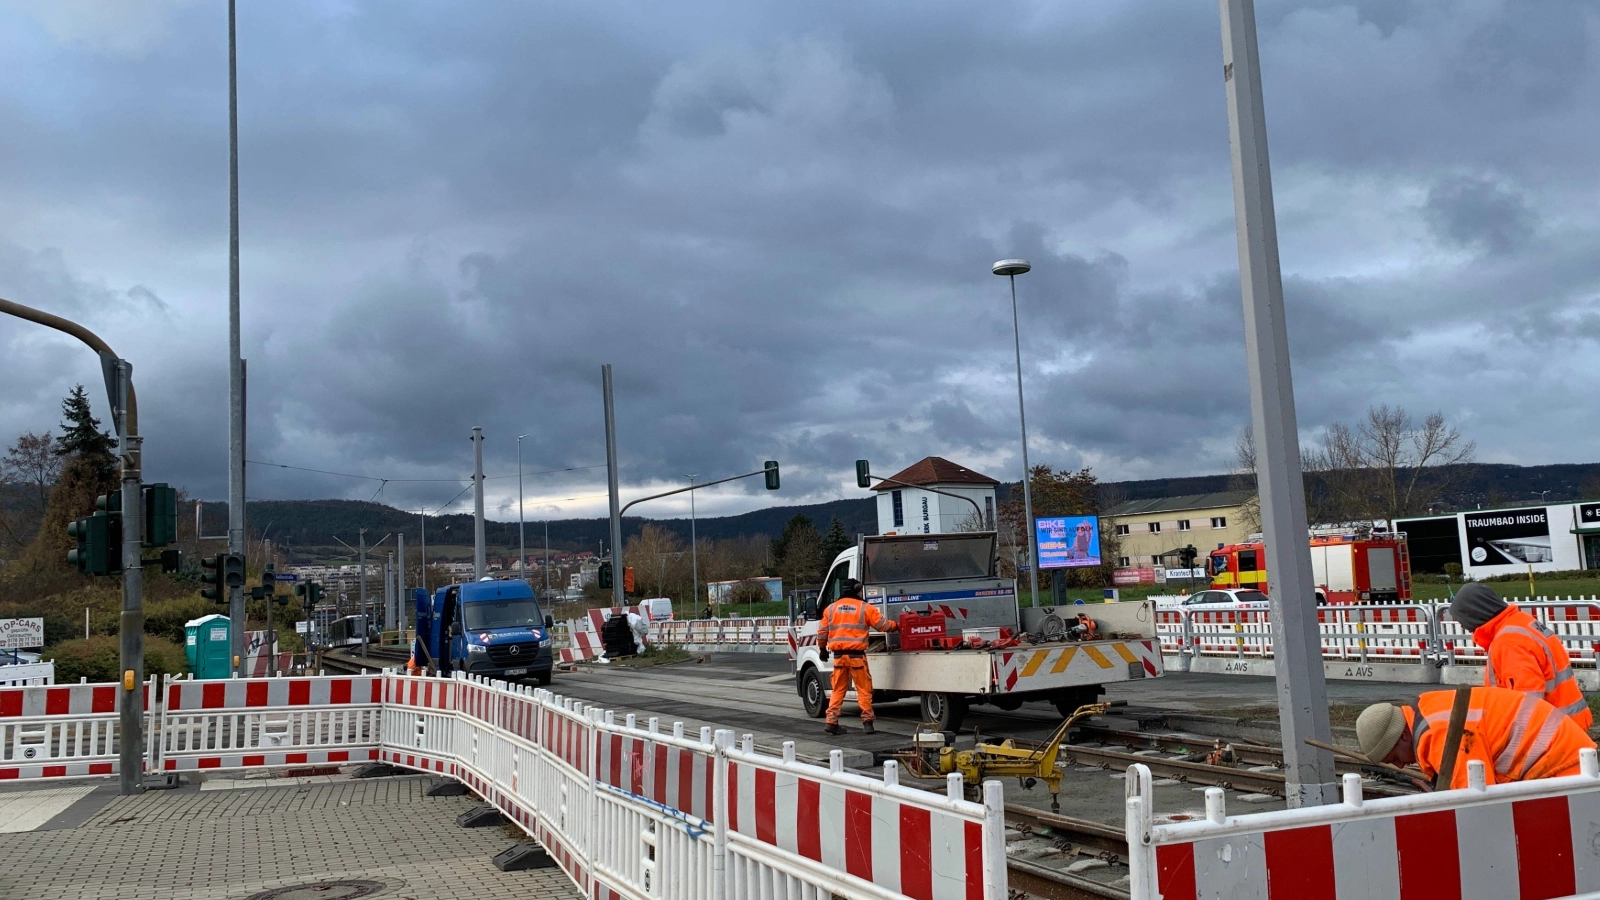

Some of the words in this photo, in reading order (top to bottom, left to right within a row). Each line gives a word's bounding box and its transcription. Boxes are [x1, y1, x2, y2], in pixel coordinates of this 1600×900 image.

[1467, 516, 1514, 528] TRAUMBAD
[1516, 514, 1546, 524] INSIDE
[911, 625, 941, 633] HILTI
[1234, 662, 1248, 672] AVS
[1356, 667, 1373, 677] AVS
